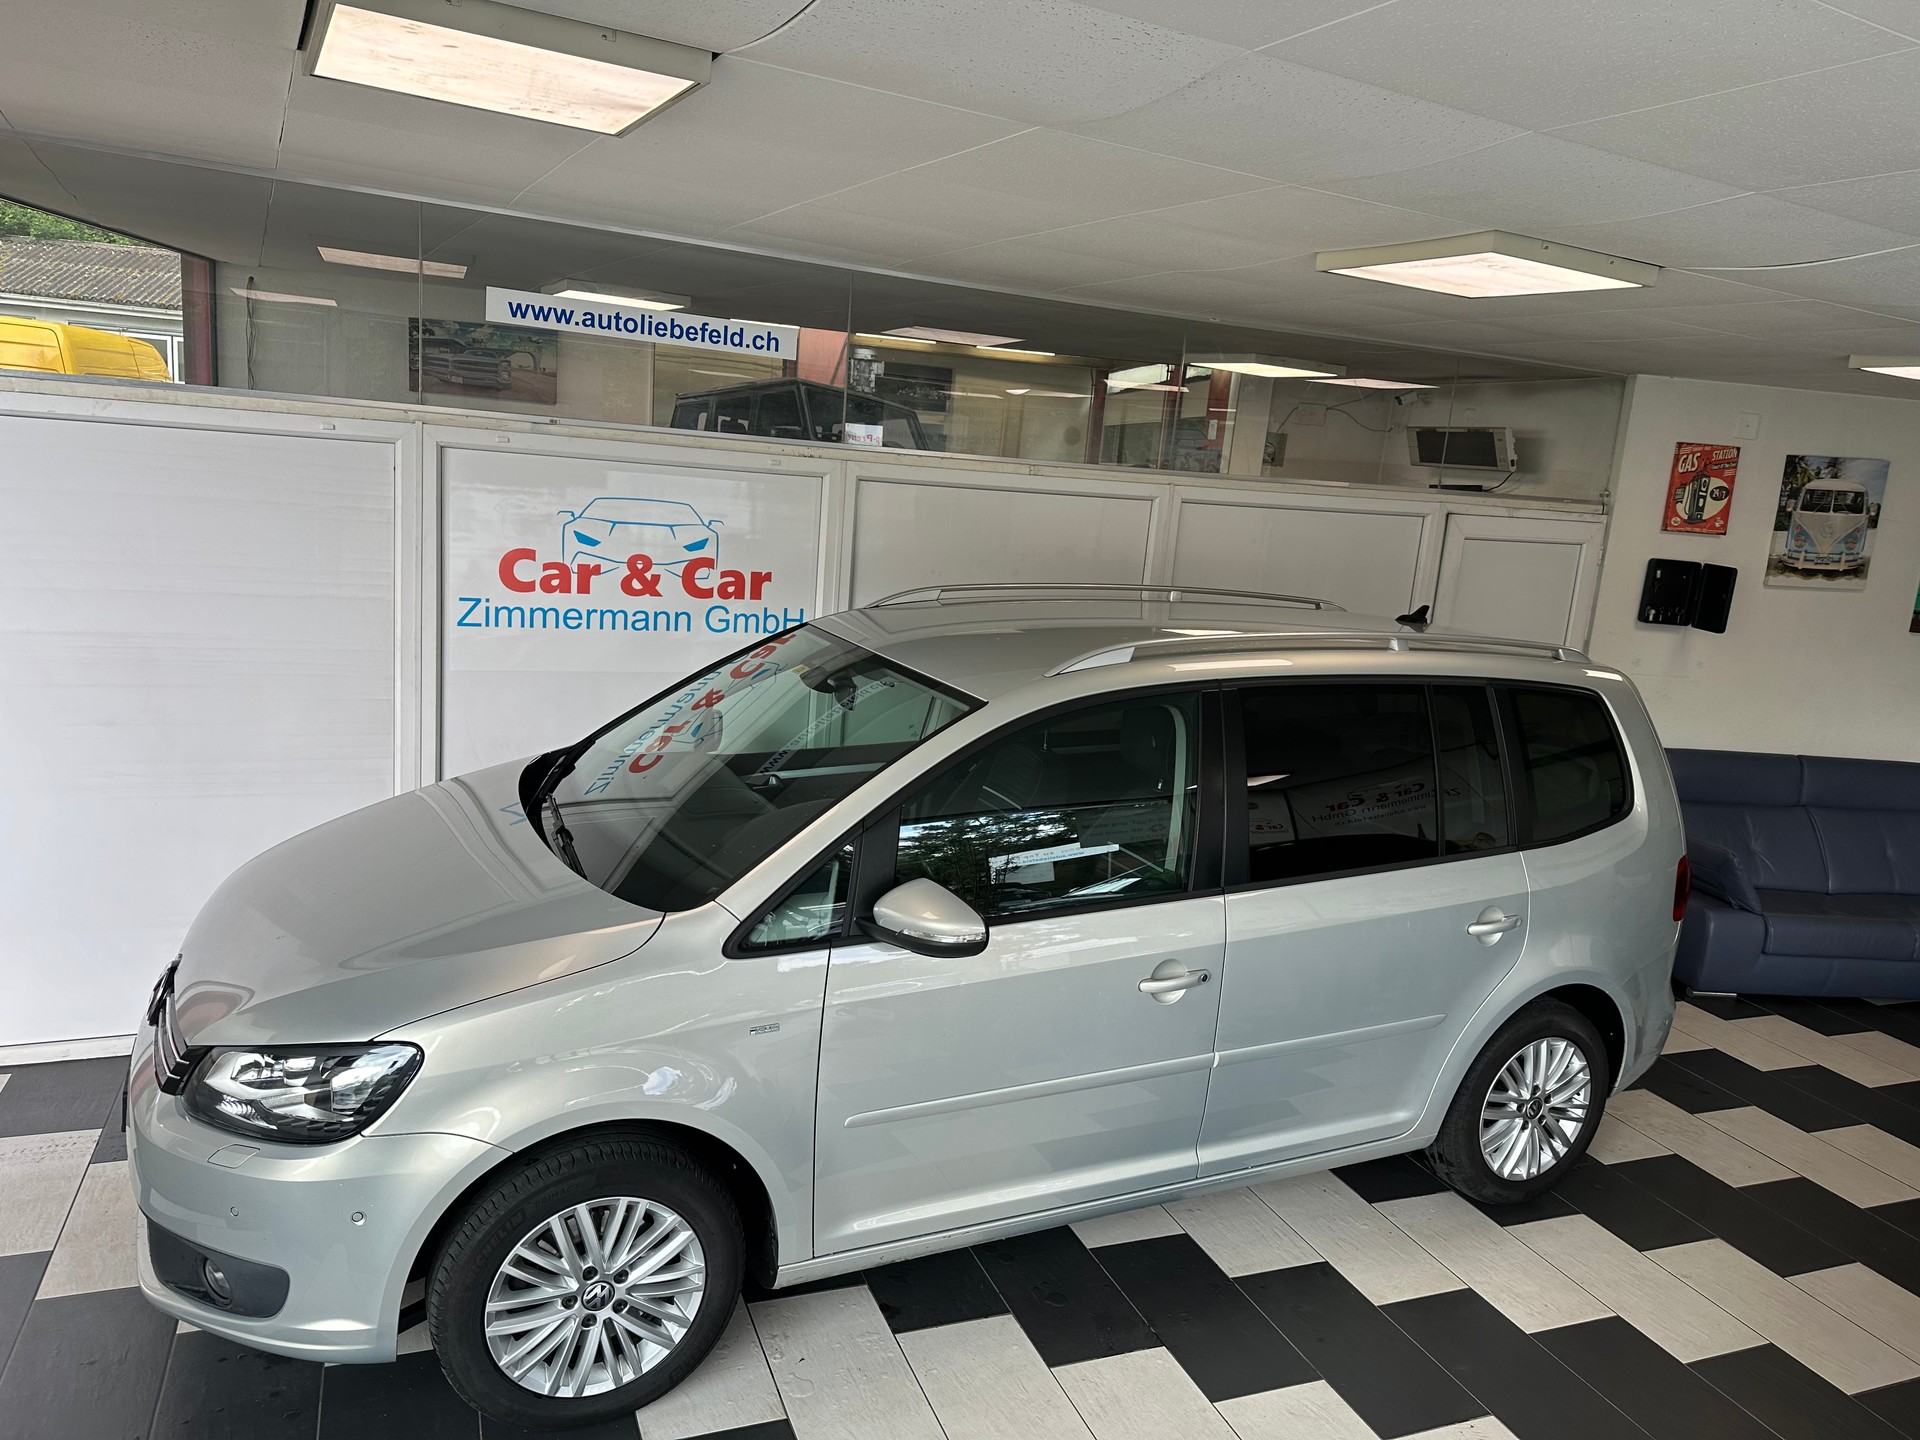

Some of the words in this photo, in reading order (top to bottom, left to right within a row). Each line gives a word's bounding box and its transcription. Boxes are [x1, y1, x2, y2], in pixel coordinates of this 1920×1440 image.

[507, 301, 780, 352] www.autoliebefeld.ch
[1678, 452, 1701, 473] GAS
[1712, 447, 1738, 461] STATION
[498, 547, 602, 595] Car
[620, 553, 664, 598] &
[681, 556, 773, 601] Car
[456, 596, 692, 632] Zimmermann
[704, 604, 805, 634] GmbH
